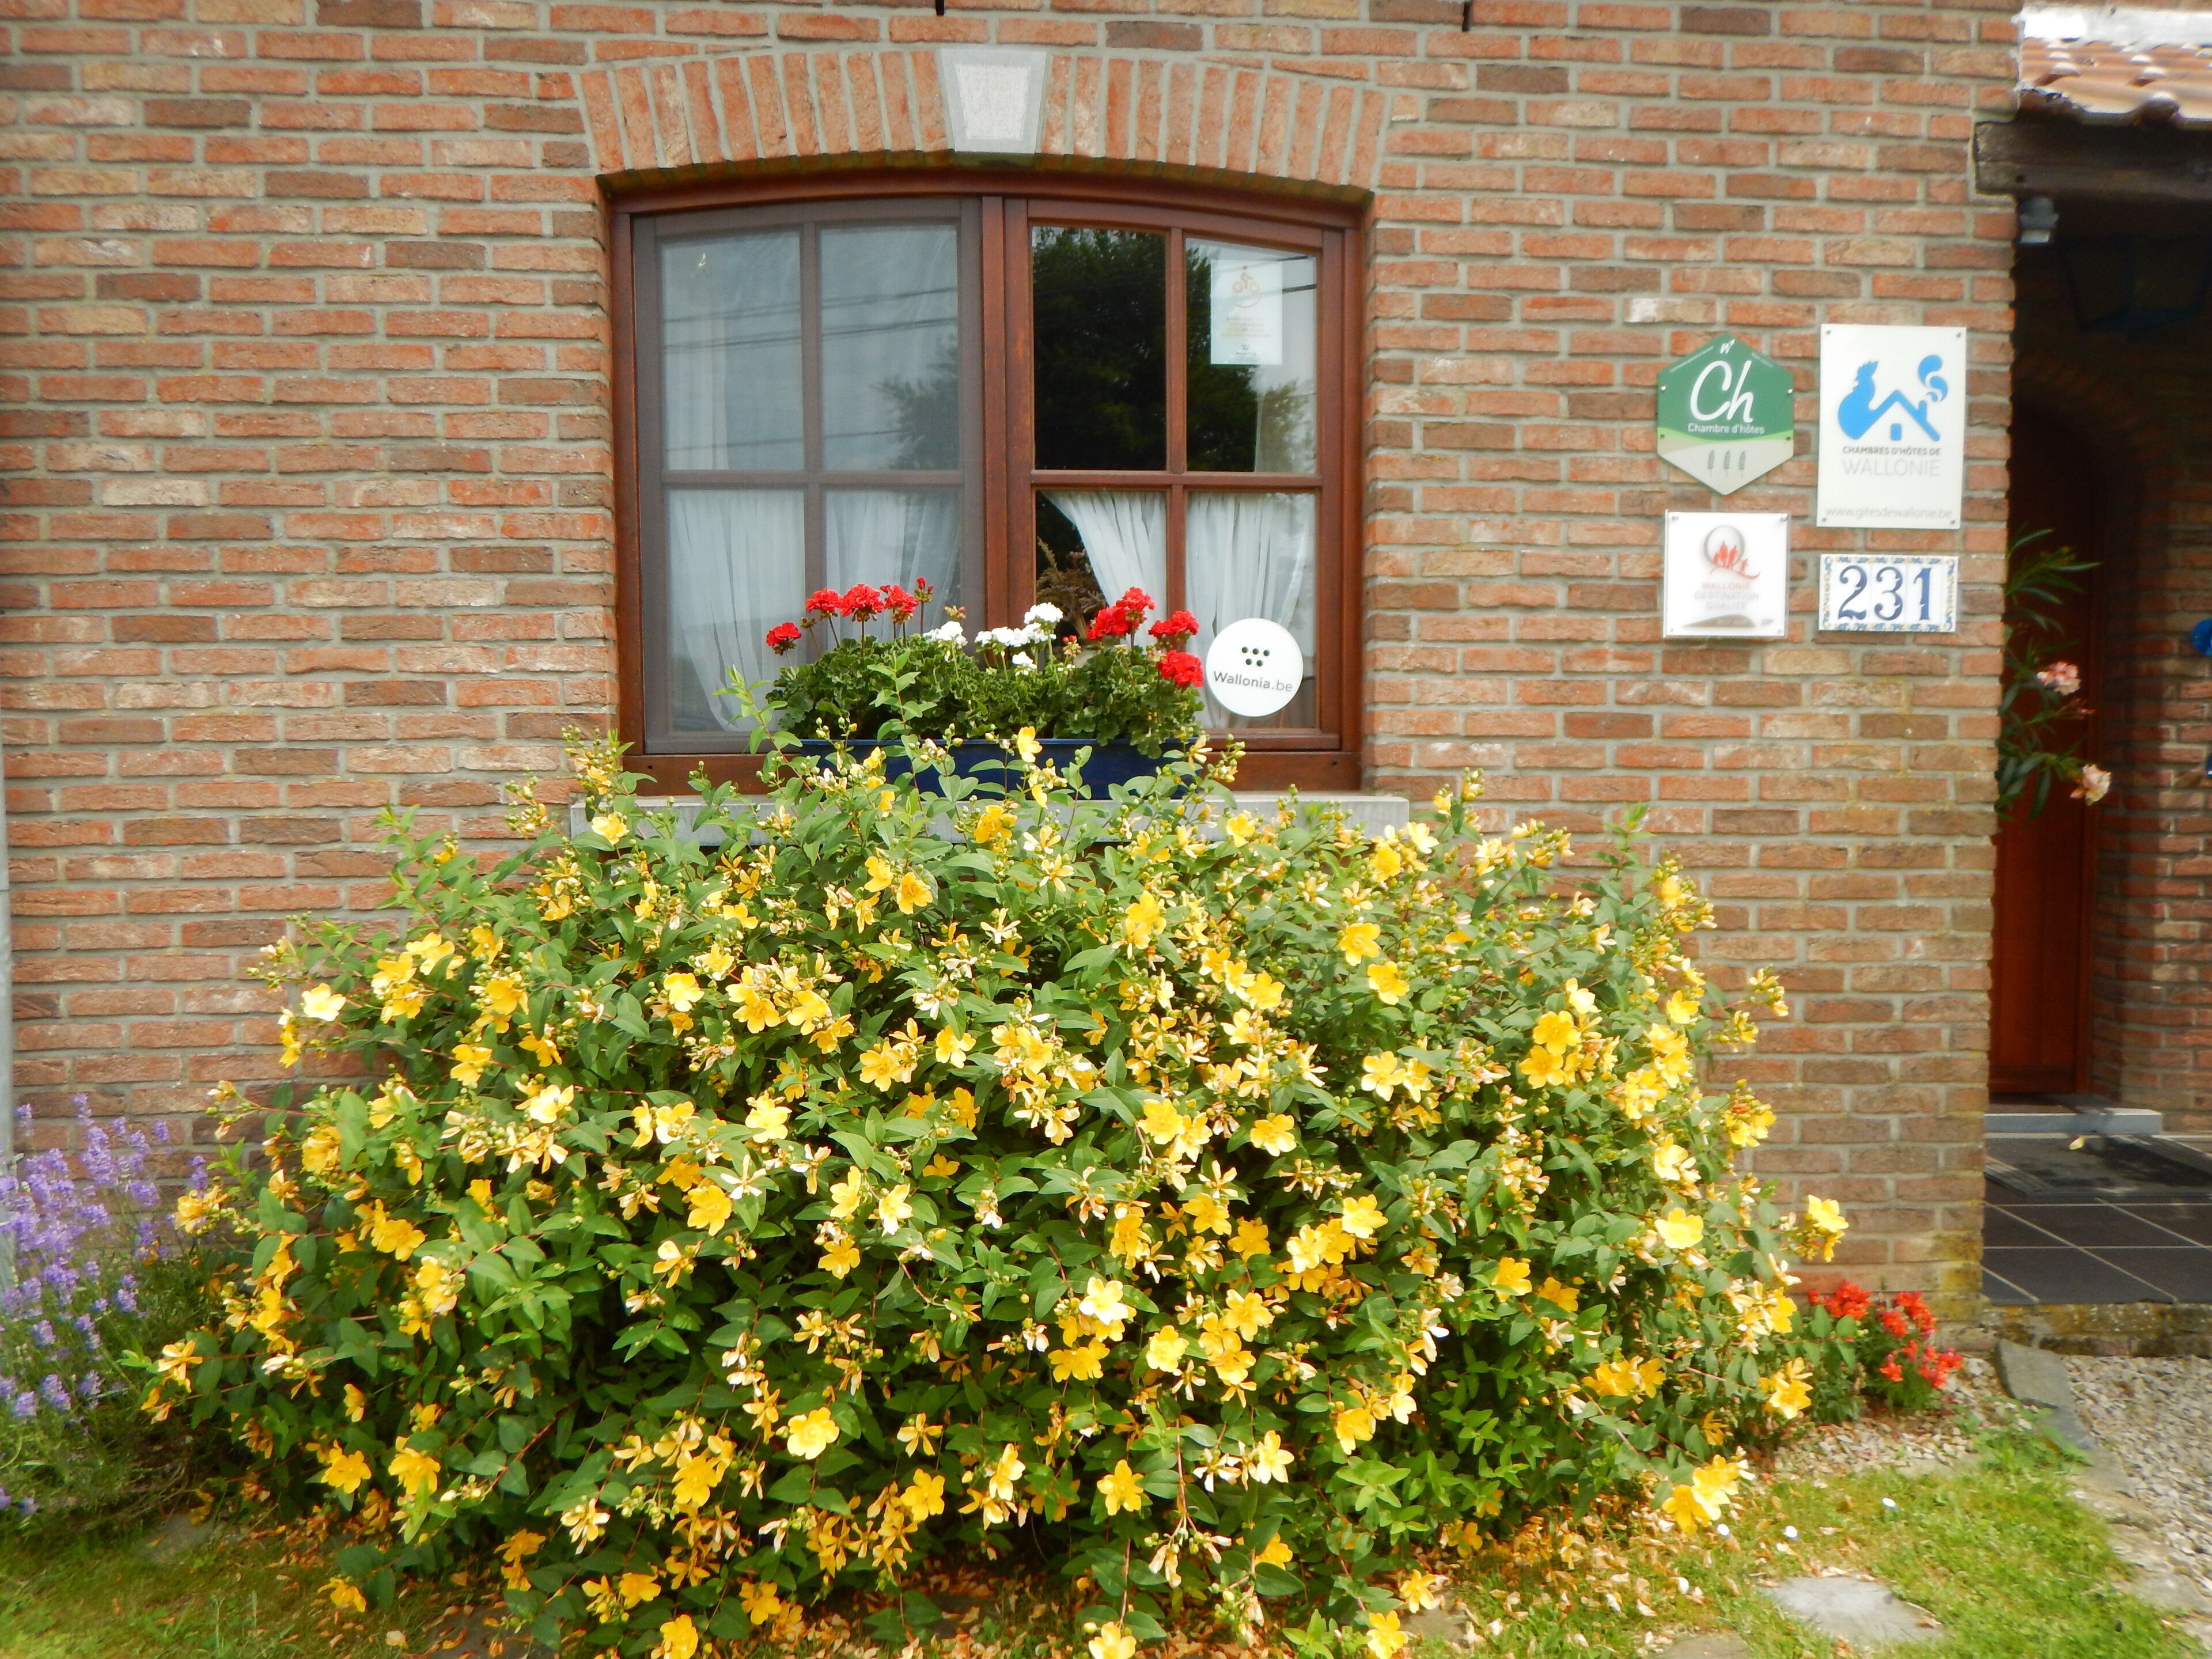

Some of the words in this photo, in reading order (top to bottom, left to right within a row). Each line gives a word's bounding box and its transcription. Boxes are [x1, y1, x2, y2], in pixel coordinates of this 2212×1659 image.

[1690, 360, 1753, 423] Ch
[1688, 422, 1729, 433] Chambre
[1732, 423, 1765, 434] d'hôtes
[1842, 446, 1889, 454] CHAMBRES
[1891, 446, 1927, 456] D'HÔTES
[1842, 459, 1941, 476] WALLONIE
[1825, 507, 1953, 520] www.gitesdewallonie.be
[1702, 582, 1751, 590] WALLONIE
[1694, 591, 1759, 599] DESTINATION
[1837, 565, 1932, 621] 231
[1213, 670, 1293, 692] Wallonia.be
